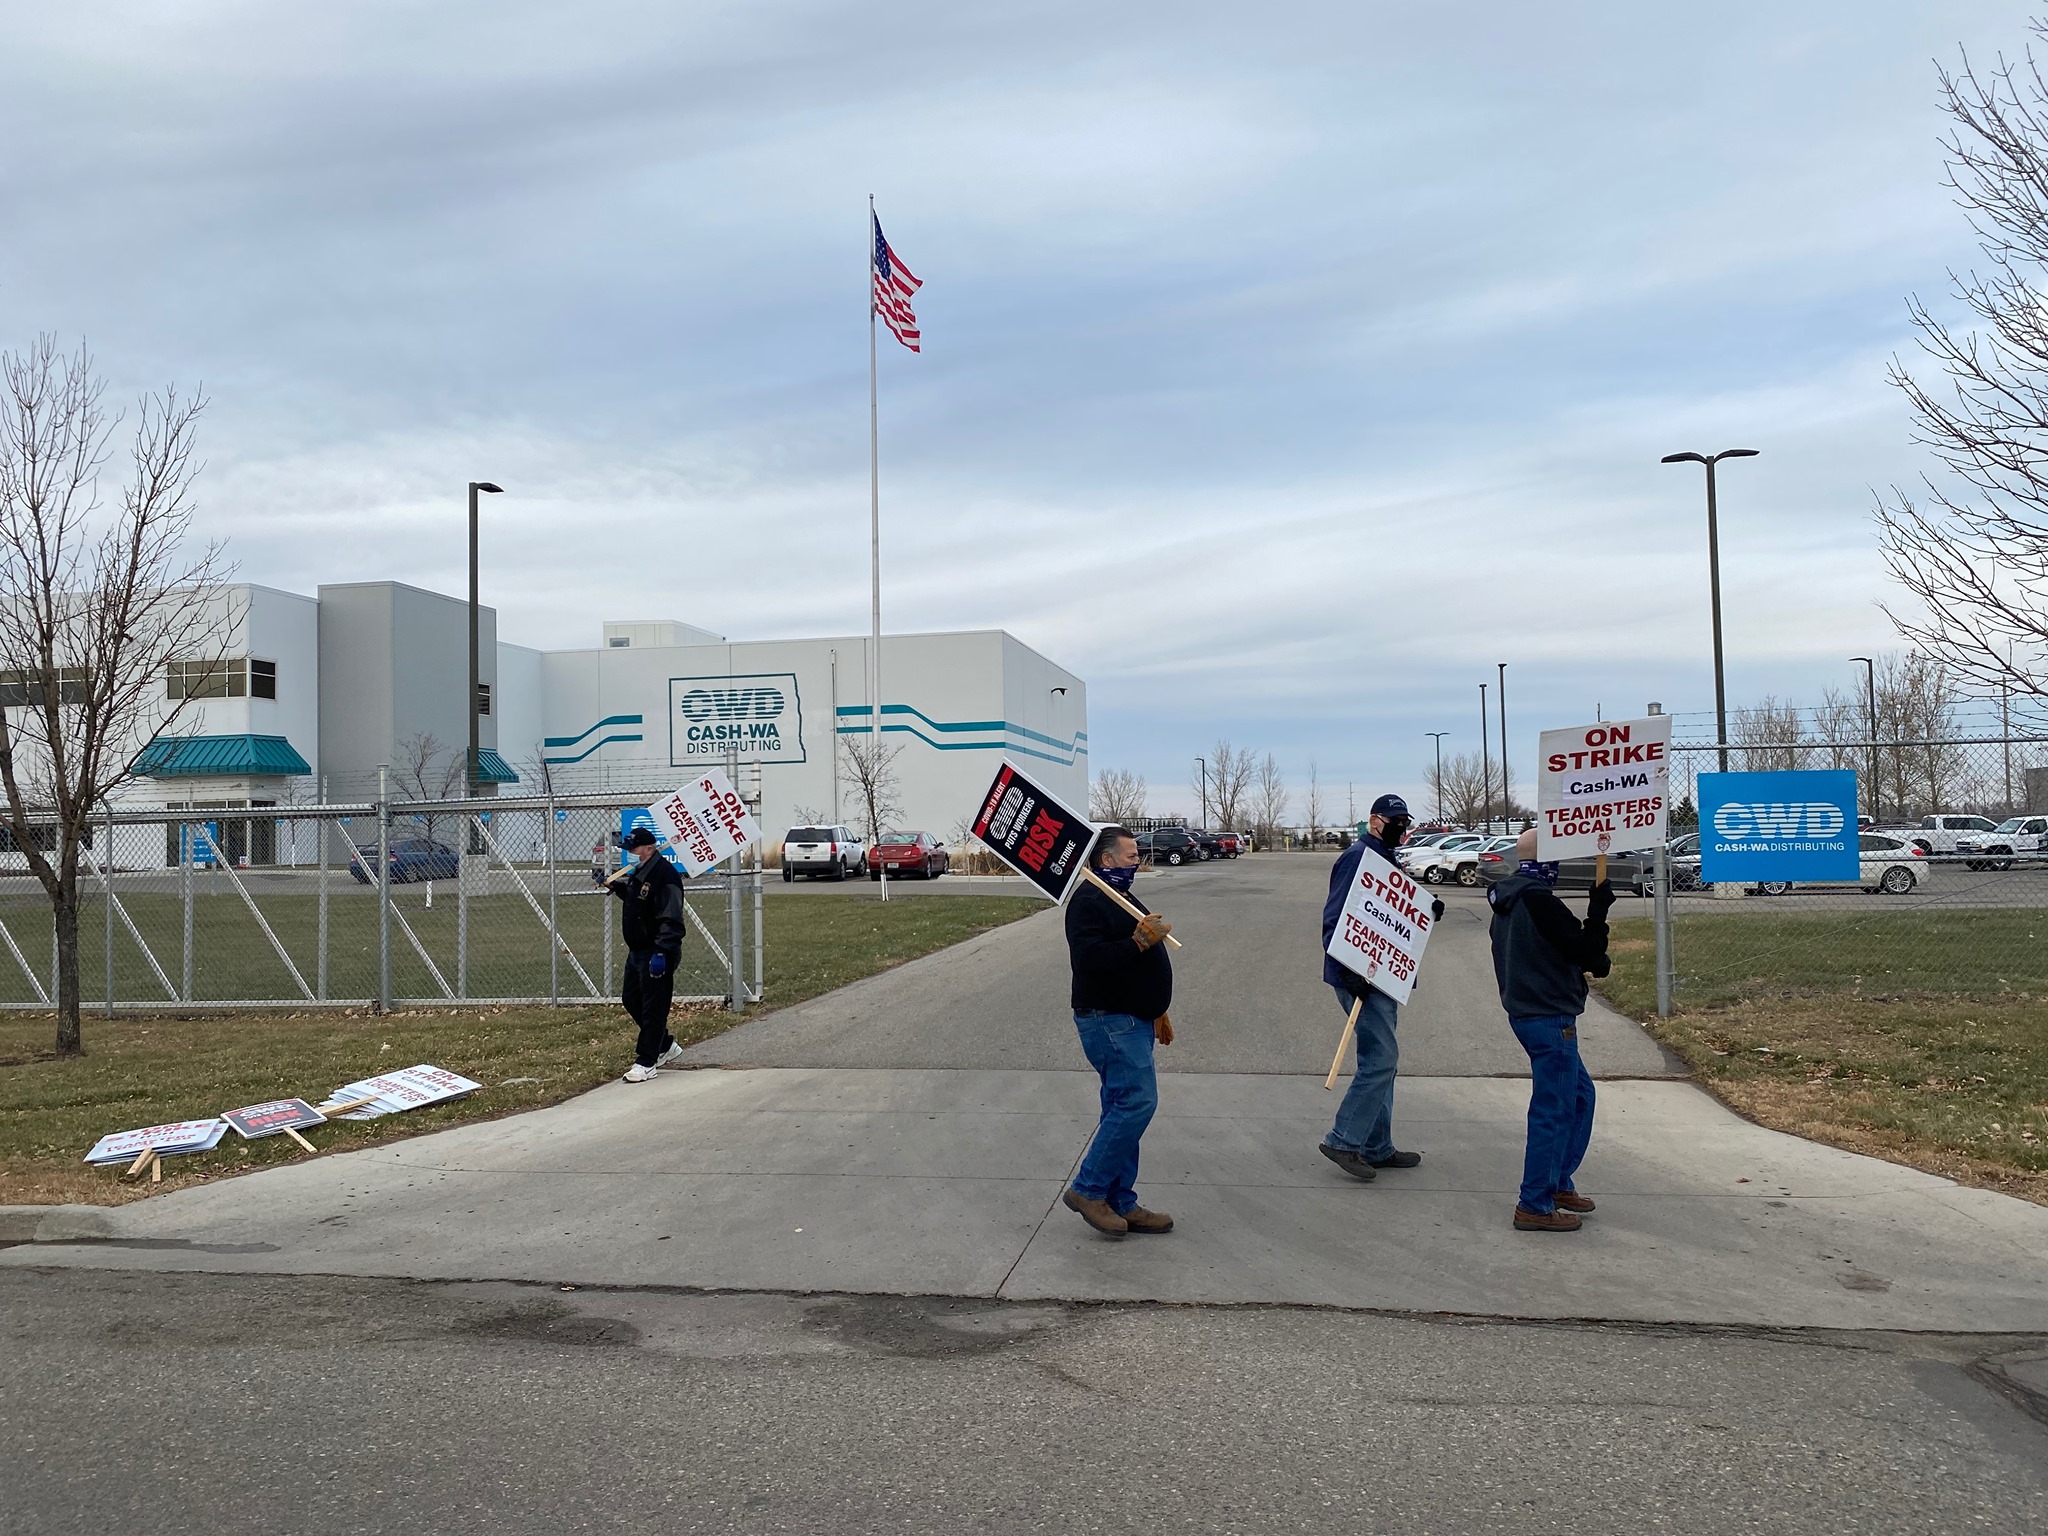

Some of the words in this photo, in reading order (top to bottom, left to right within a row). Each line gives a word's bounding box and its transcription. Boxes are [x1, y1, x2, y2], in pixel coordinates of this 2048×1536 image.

[681, 688, 785, 723] CWD
[687, 723, 780, 740] CASH-WA
[1585, 725, 1631, 747] ON
[1547, 742, 1665, 773] STRIKE
[993, 781, 1006, 801] ALERT
[1570, 773, 1649, 795] Cash-WA
[703, 779, 747, 845] STRIKE
[724, 792, 746, 820] ON
[1545, 796, 1663, 823] TEAMSTERS
[665, 804, 692, 842] LOCAL
[690, 843, 706, 863] 120
[671, 795, 717, 862] TEAMSTERS
[702, 808, 720, 832] HJH
[1004, 830, 1018, 850] PUTS
[1012, 797, 1036, 832] WORKERS
[1552, 818, 1616, 838] LOCAL
[1623, 812, 1656, 829] 120
[1713, 802, 1845, 840] CWD
[1018, 808, 1064, 872] RISK
[1058, 840, 1077, 867] STRIKE
[1715, 843, 1769, 852] CASH-WA
[1771, 842, 1845, 851] DISTRIBUTING
[1388, 870, 1417, 900] ON
[1360, 871, 1431, 932] STRIKE
[1364, 900, 1411, 942] Cash-WA
[1344, 929, 1384, 966] LOCAL
[1388, 960, 1408, 981] 120
[1346, 913, 1416, 972] TEAMSTERS
[365, 1080, 398, 1094] LOCAL
[373, 1077, 431, 1101] TEAMSTERS
[403, 1069, 463, 1092] STRIKE
[432, 1070, 459, 1081] ON
[247, 1109, 304, 1127] RISK
